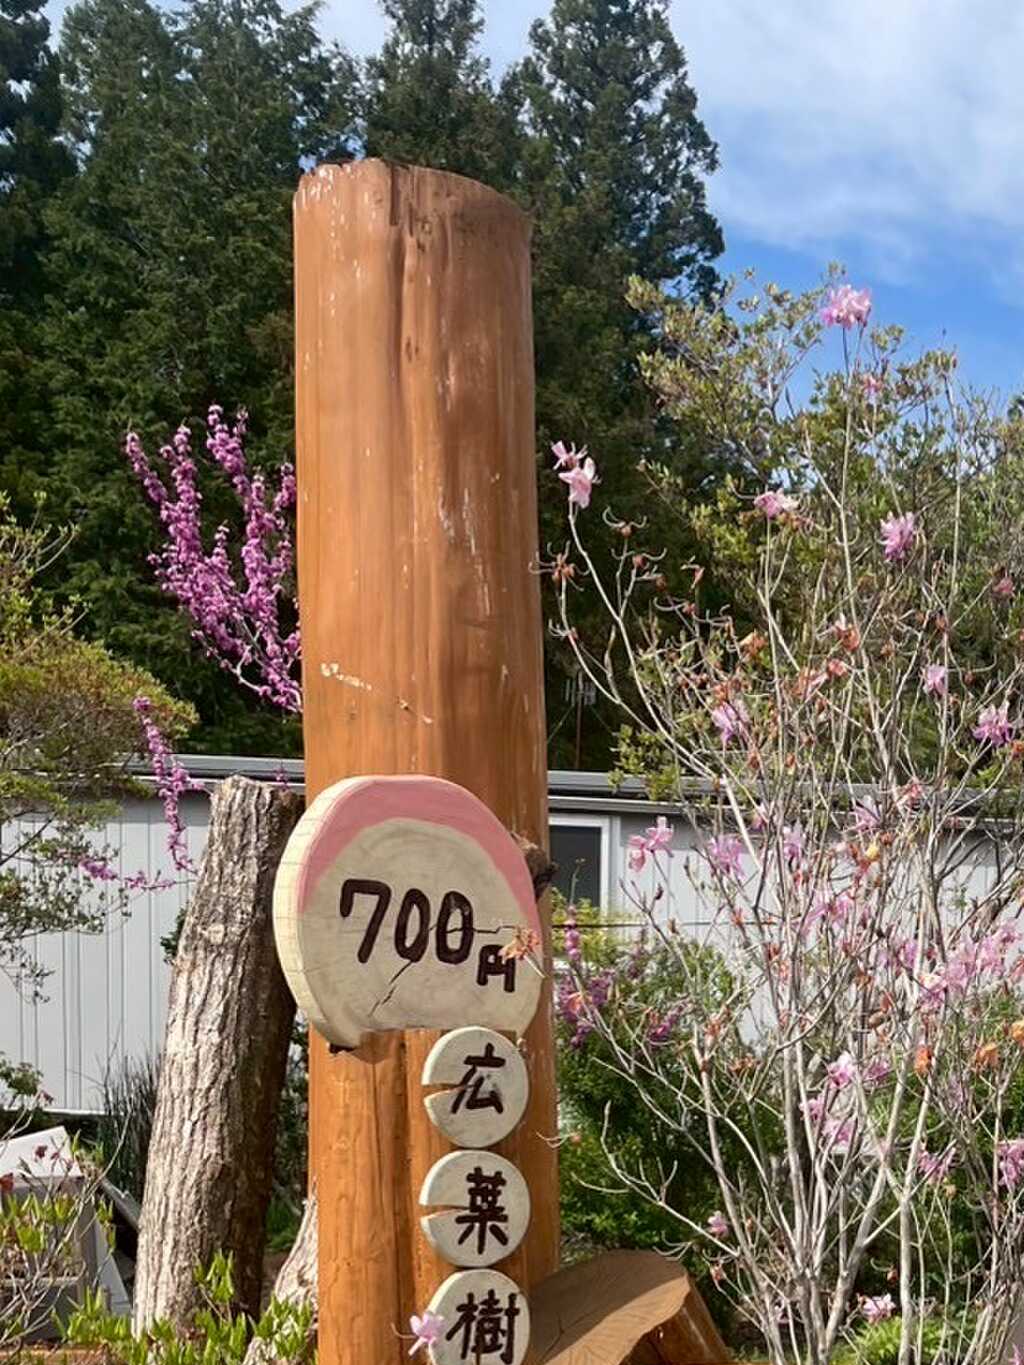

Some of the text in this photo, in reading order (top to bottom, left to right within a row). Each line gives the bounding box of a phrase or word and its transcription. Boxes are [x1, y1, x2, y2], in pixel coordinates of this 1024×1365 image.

[340, 879, 515, 993] 700円
[447, 1043, 520, 1365] 広葉樹
